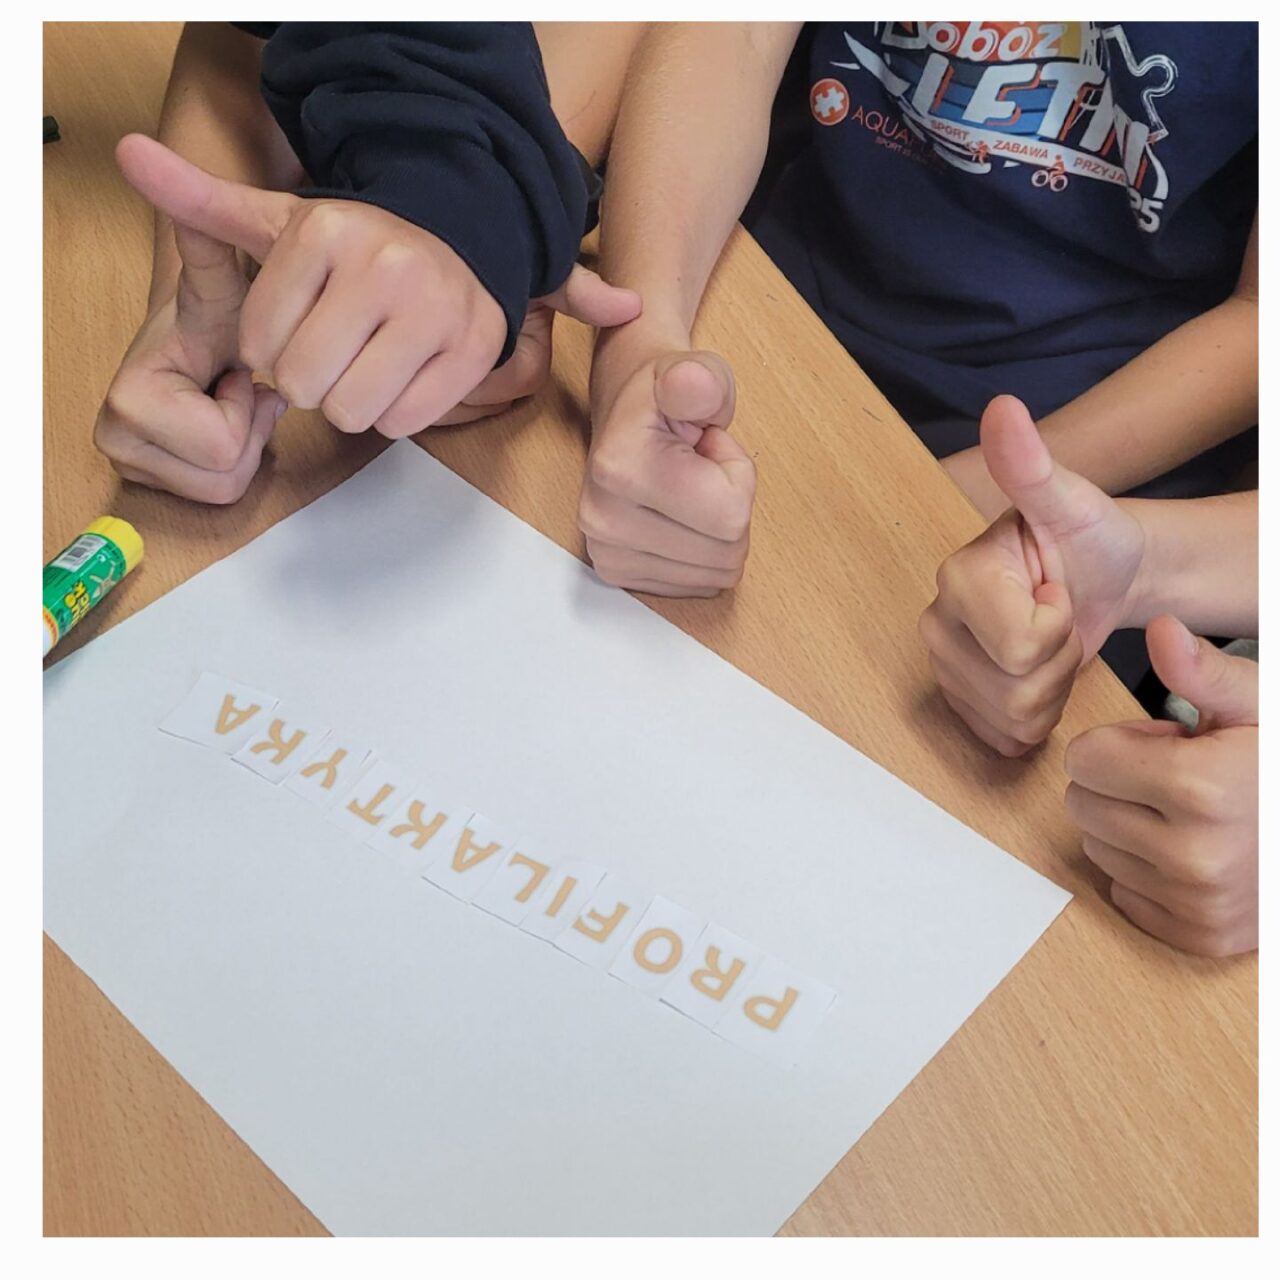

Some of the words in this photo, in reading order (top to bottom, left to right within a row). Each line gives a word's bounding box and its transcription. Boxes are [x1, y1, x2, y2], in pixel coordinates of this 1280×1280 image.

[931, 120, 970, 141] SPORT
[992, 139, 1048, 160] ZABAWA
[214, 692, 800, 1032] PROFILAKTYKA
